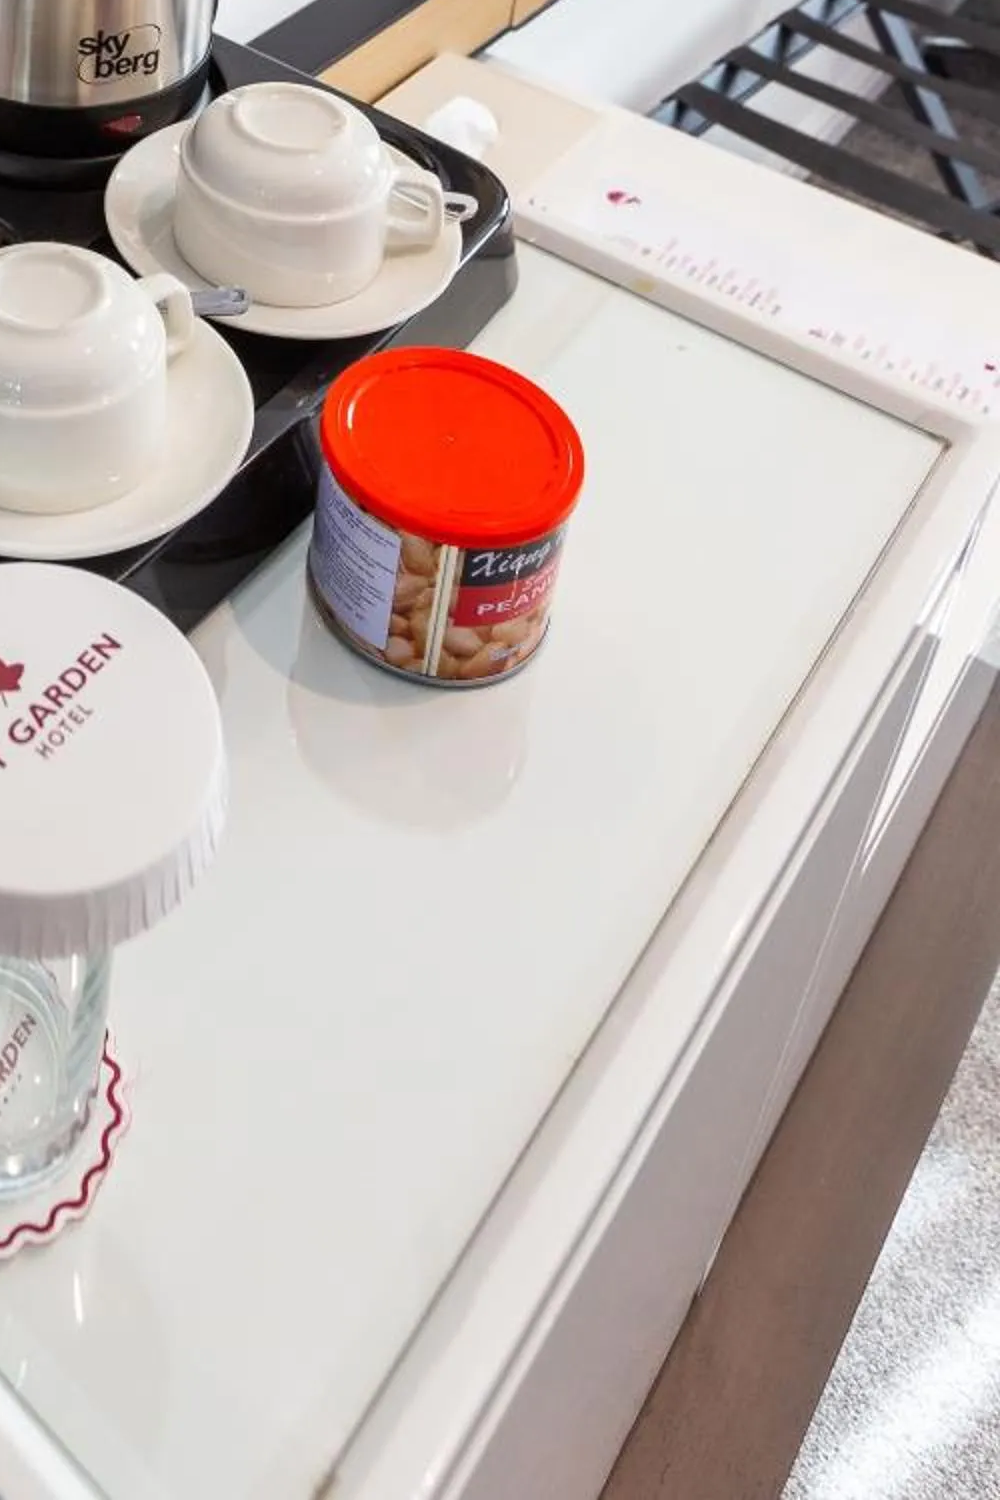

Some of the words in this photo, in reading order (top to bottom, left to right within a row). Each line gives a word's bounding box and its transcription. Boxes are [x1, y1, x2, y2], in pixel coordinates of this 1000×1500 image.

[78, 30, 131, 59] sky
[94, 49, 160, 79] berg
[7, 632, 123, 745] GARDEN
[35, 704, 94, 760] HOTEL
